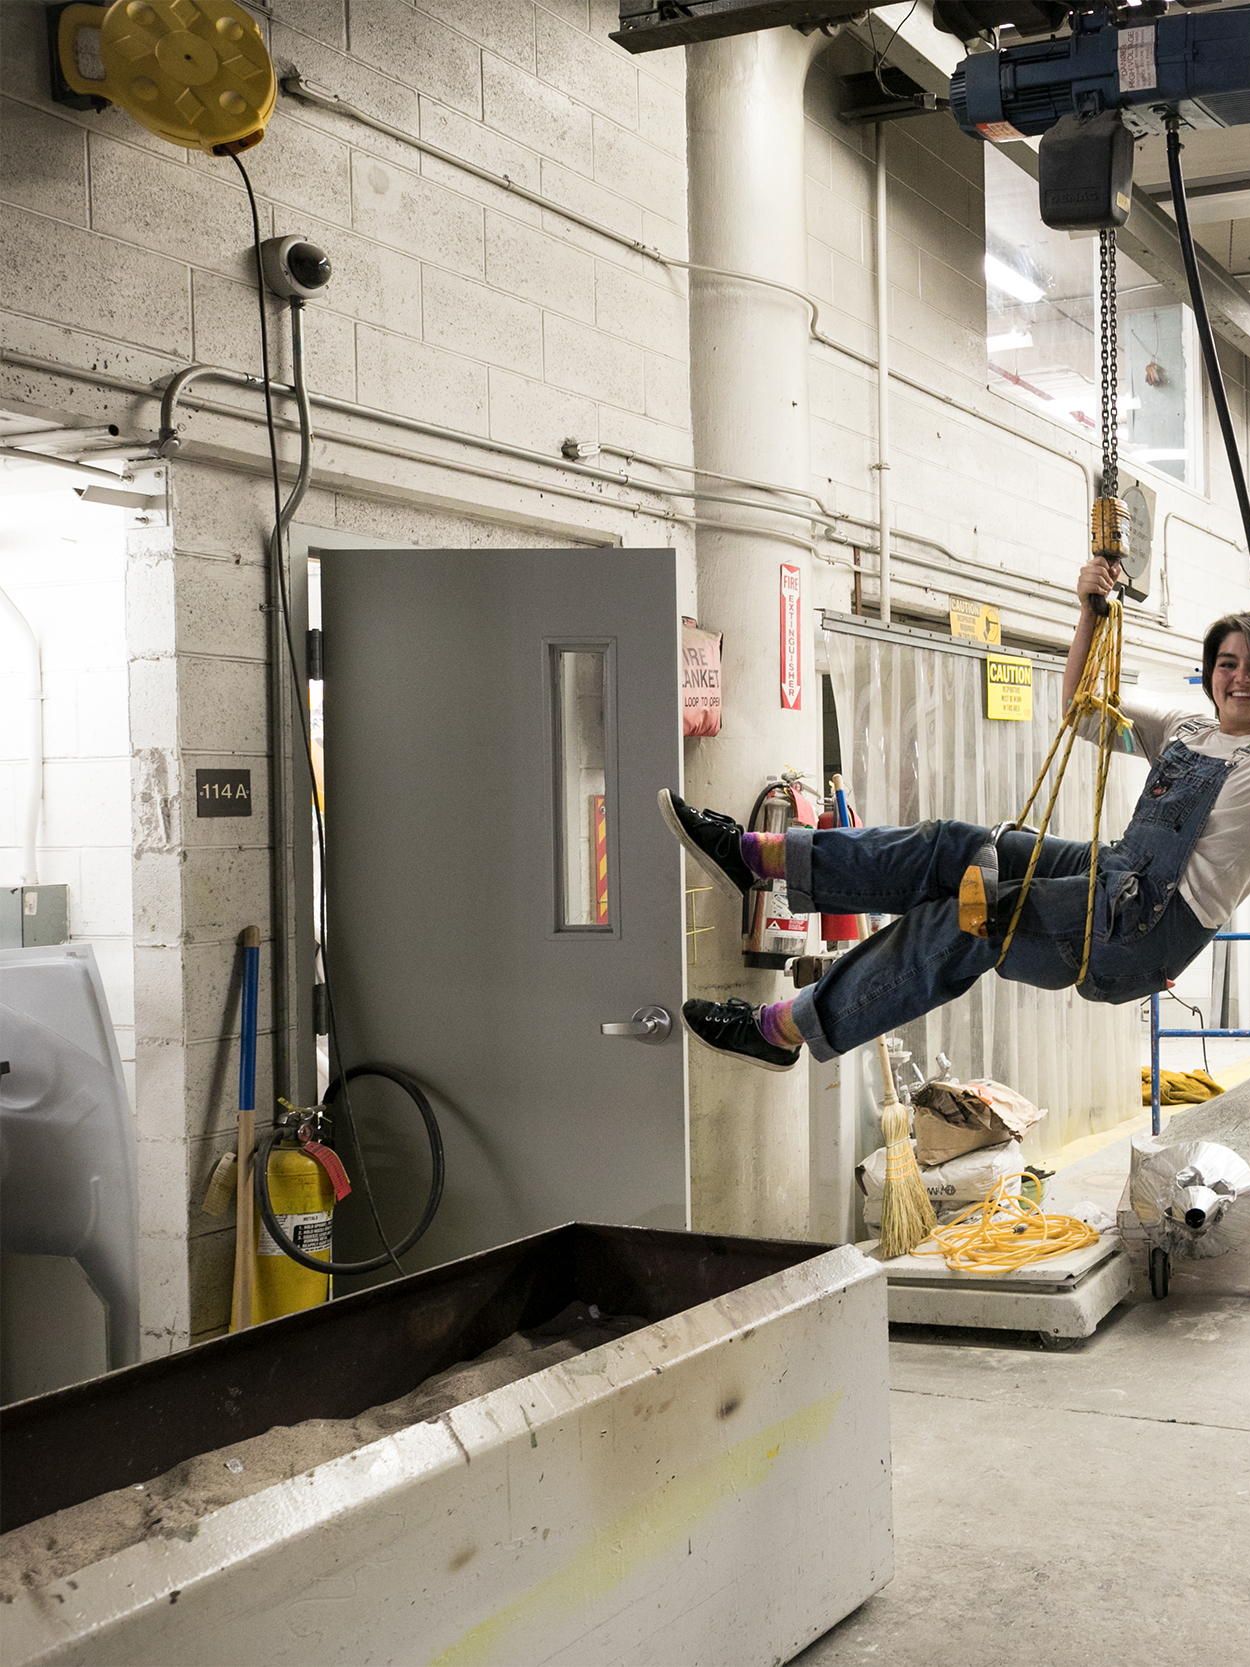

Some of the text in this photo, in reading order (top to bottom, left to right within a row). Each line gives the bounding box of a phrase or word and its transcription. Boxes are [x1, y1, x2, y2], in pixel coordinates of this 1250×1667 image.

[1120, 44, 1128, 77] DANGER
[783, 575, 798, 591] FIRE
[682, 648, 708, 666] IRE
[682, 669, 719, 688] ANKET
[990, 663, 1031, 685] CAUTION
[685, 696, 699, 707] LOOP
[701, 697, 708, 706] TO
